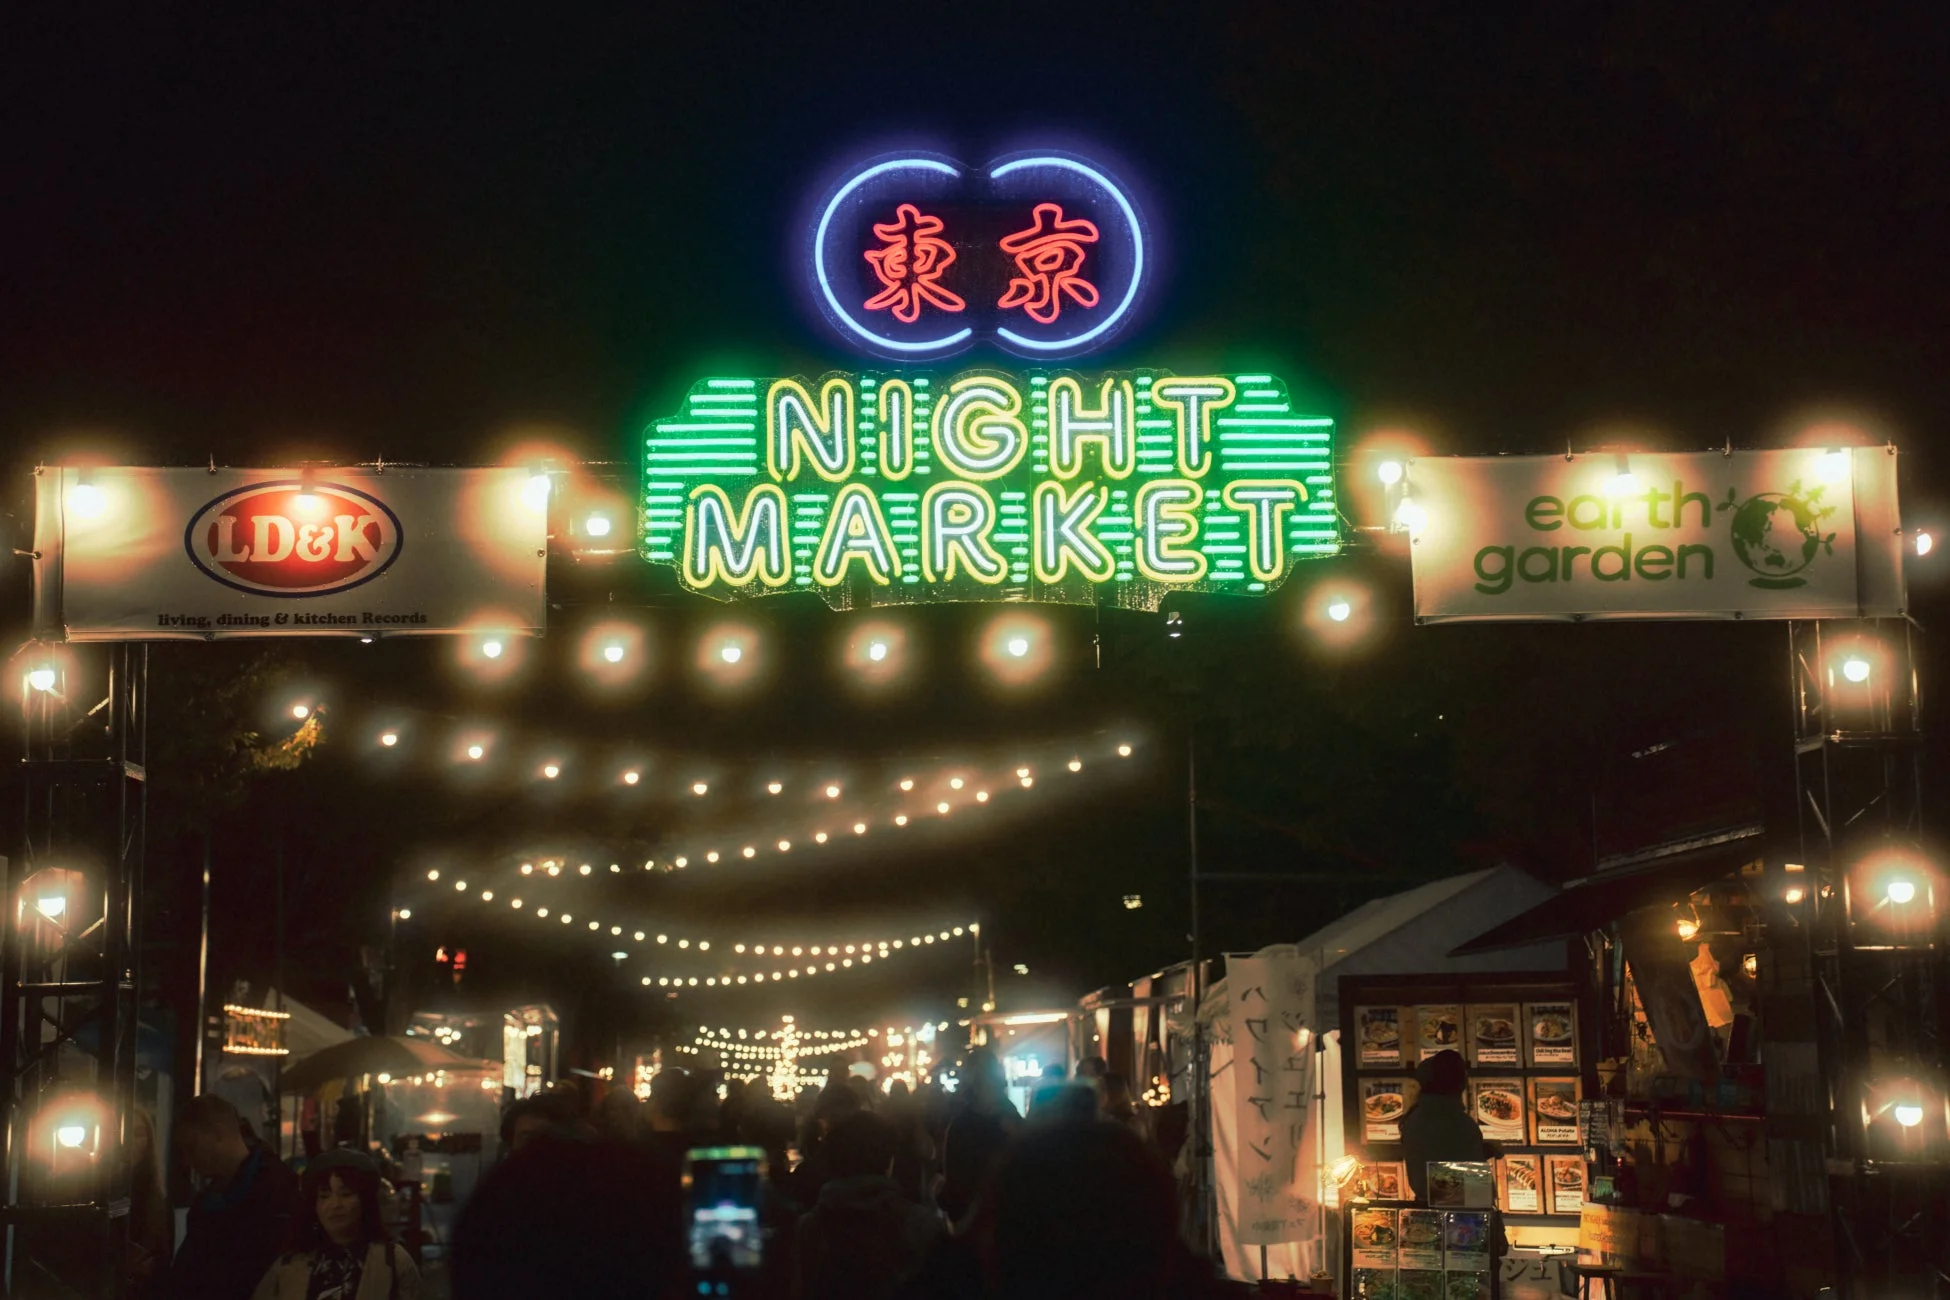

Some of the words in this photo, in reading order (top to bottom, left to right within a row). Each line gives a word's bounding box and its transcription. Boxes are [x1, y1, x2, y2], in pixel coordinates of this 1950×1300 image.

[863, 203, 1100, 324] 東京
[767, 377, 1234, 481] NIGHT
[214, 515, 380, 563] LD&K
[682, 480, 1307, 588] MARKET
[1473, 532, 1714, 595] garden
[158, 614, 211, 628] living,
[216, 613, 270, 627] dining
[274, 613, 288, 624] &
[293, 613, 356, 625] kitchen
[361, 612, 427, 624] Records
